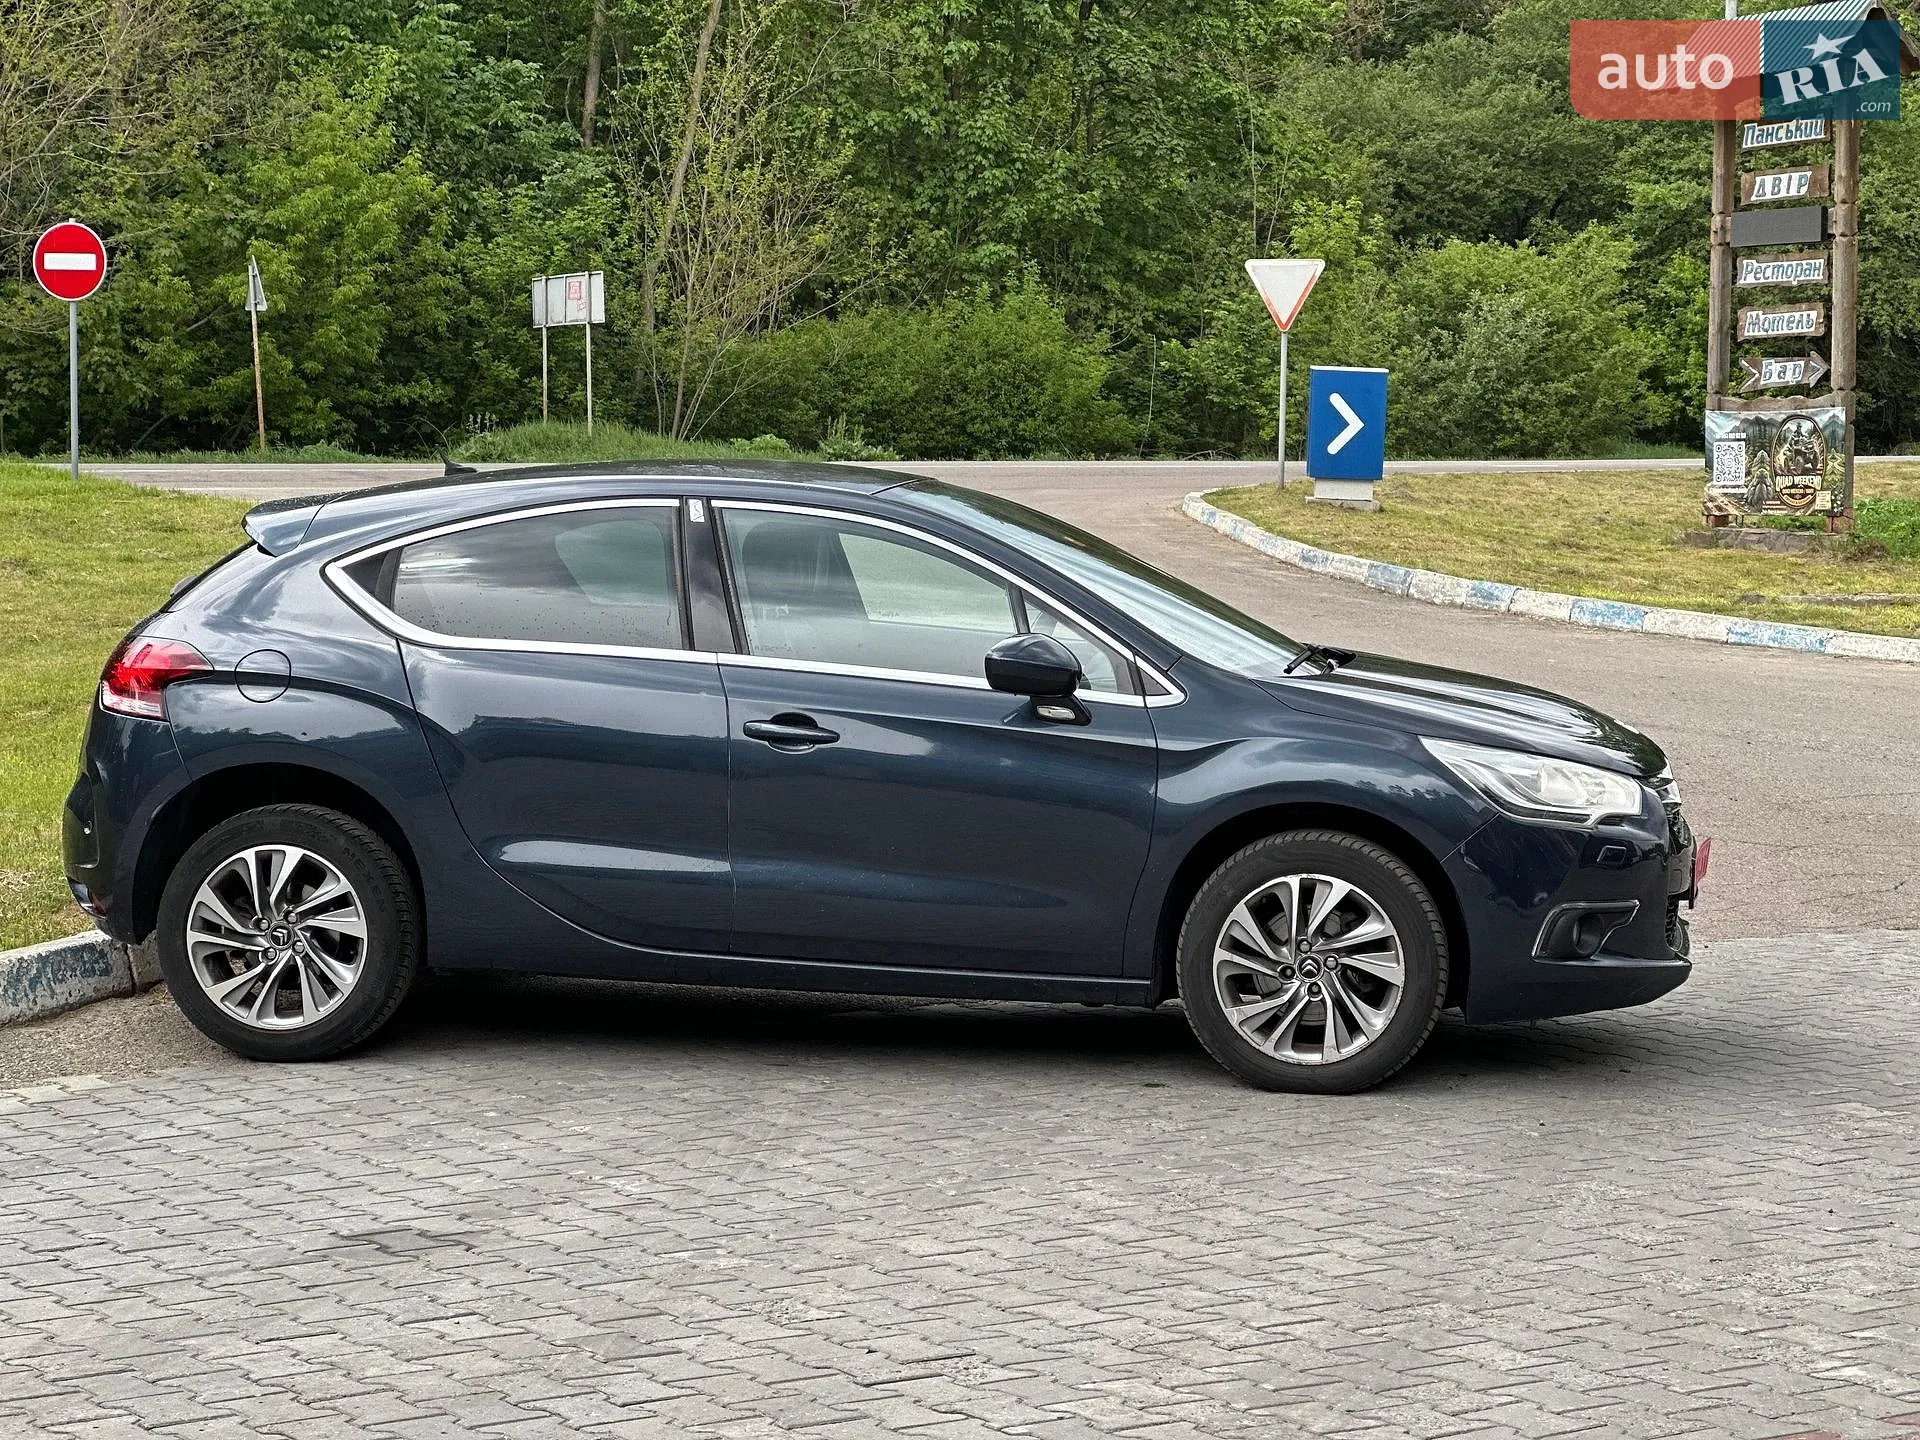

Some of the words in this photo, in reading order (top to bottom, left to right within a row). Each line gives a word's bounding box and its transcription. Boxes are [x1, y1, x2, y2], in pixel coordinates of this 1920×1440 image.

[1744, 115, 1825, 147] Панський
[1755, 173, 1809, 198] ДВІР
[1743, 260, 1822, 282] Ресторан
[1746, 312, 1815, 334] Мотель
[1762, 361, 1803, 383] Бар
[1793, 475, 1822, 490] WEEKEND
